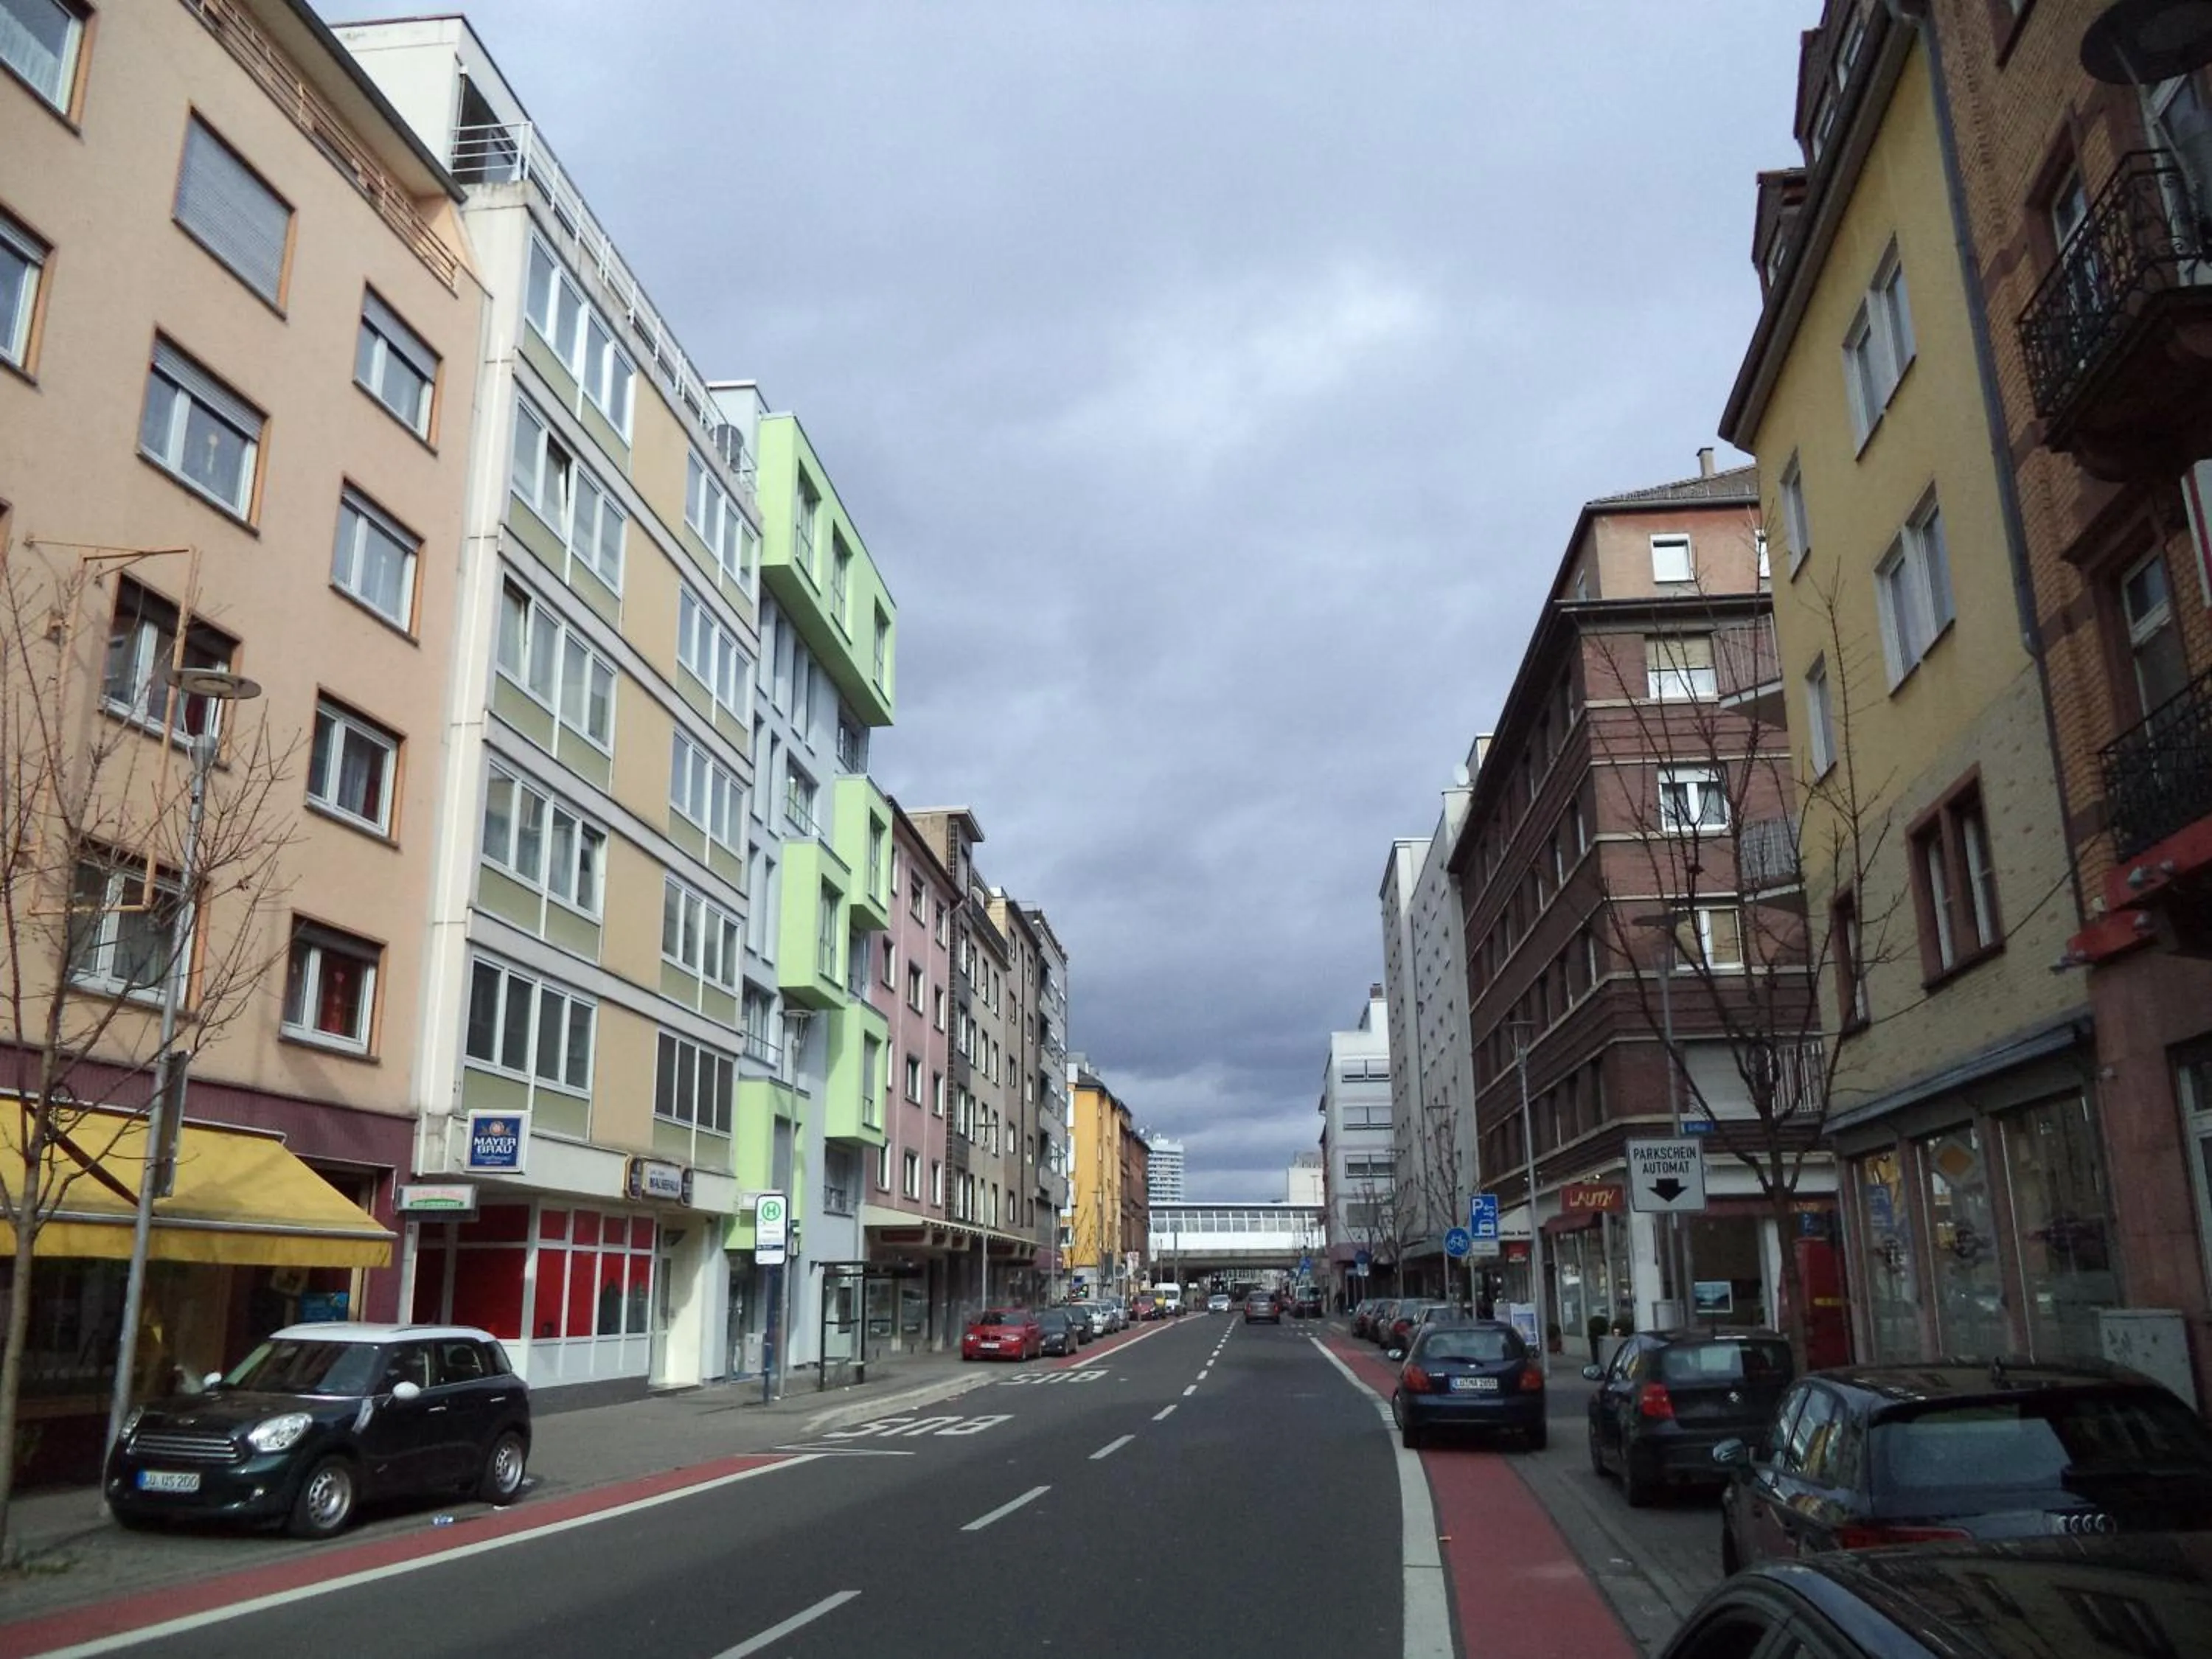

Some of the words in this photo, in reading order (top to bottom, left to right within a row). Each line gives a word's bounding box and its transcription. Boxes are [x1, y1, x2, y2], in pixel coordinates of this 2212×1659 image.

[473, 1137, 517, 1146] MAYER
[1633, 1147, 1697, 1160] PARKSCHEIN
[1642, 1161, 1690, 1175] AUTOMAT
[1472, 1198, 1484, 1216] P
[998, 1369, 1109, 1385] BUS
[822, 1414, 1015, 1437] BUS
